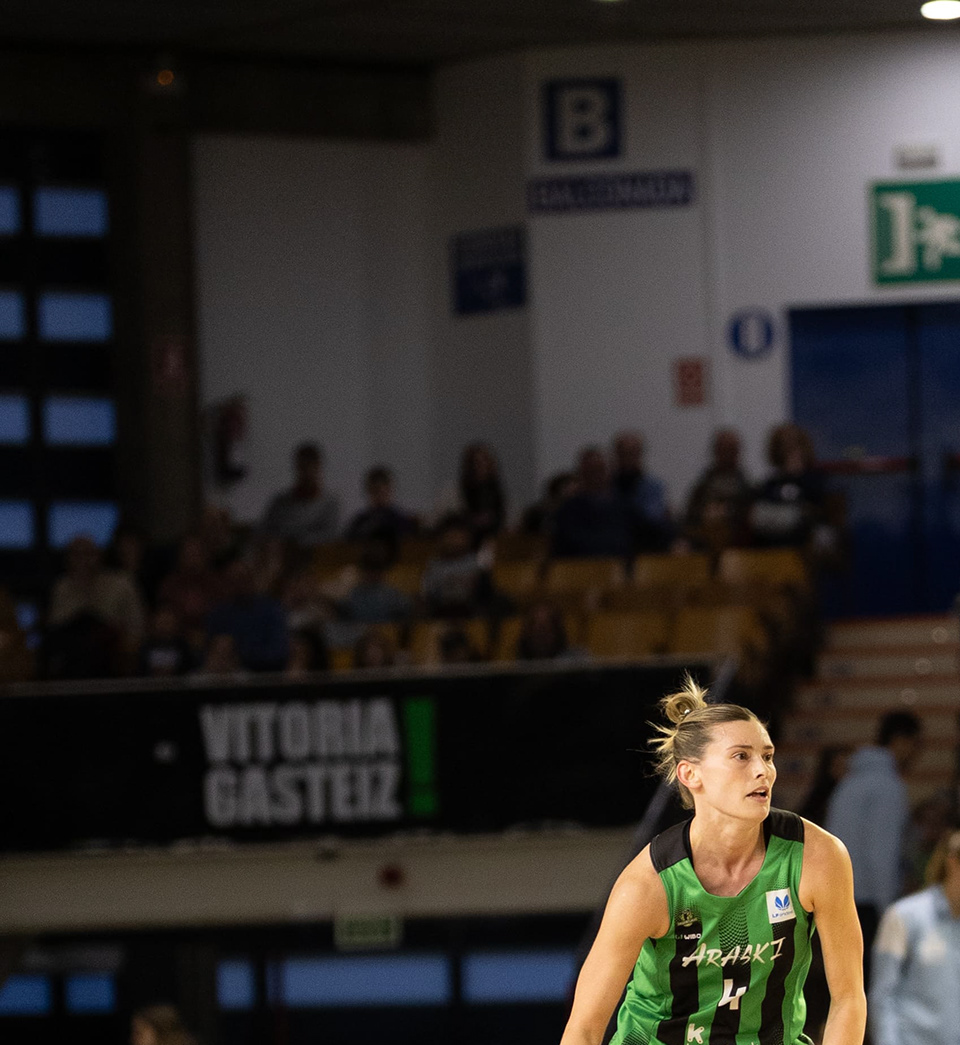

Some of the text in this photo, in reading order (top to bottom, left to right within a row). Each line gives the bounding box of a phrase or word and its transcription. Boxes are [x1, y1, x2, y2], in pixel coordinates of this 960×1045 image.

[557, 87, 611, 153] B
[200, 697, 400, 761] VITORIA
[203, 763, 401, 826] GASTEIZ
[682, 937, 786, 968] ARASKI
[718, 978, 747, 1010] 4
